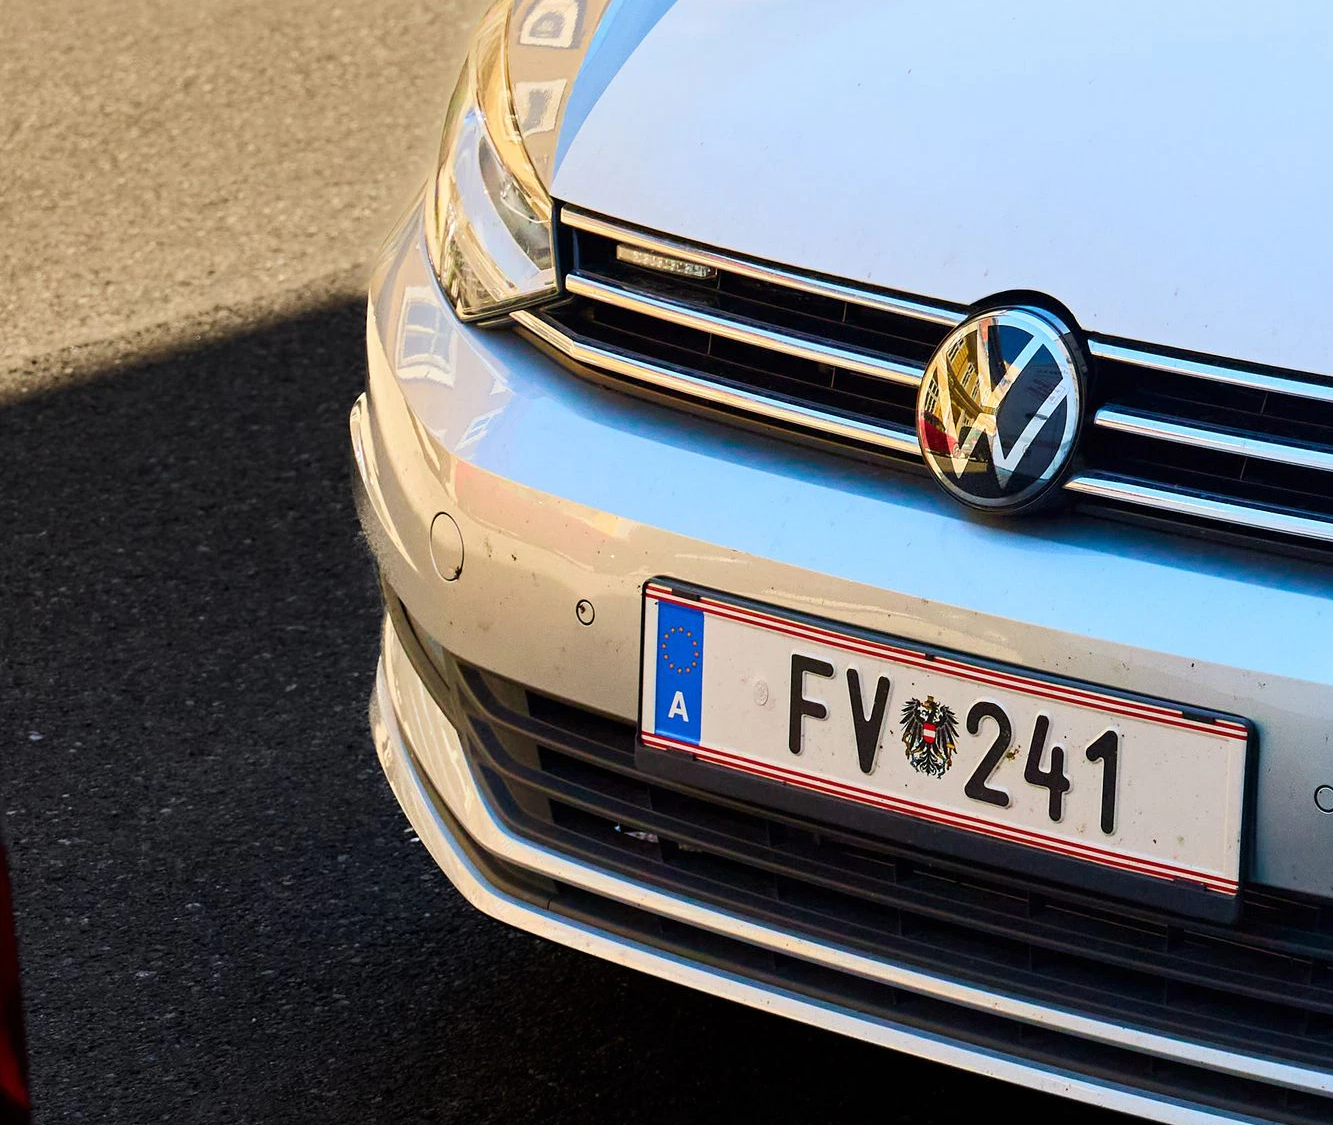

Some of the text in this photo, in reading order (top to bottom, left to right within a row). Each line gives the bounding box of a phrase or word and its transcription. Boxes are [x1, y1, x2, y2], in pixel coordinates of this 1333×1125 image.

[667, 653, 1118, 835] A FV 241
